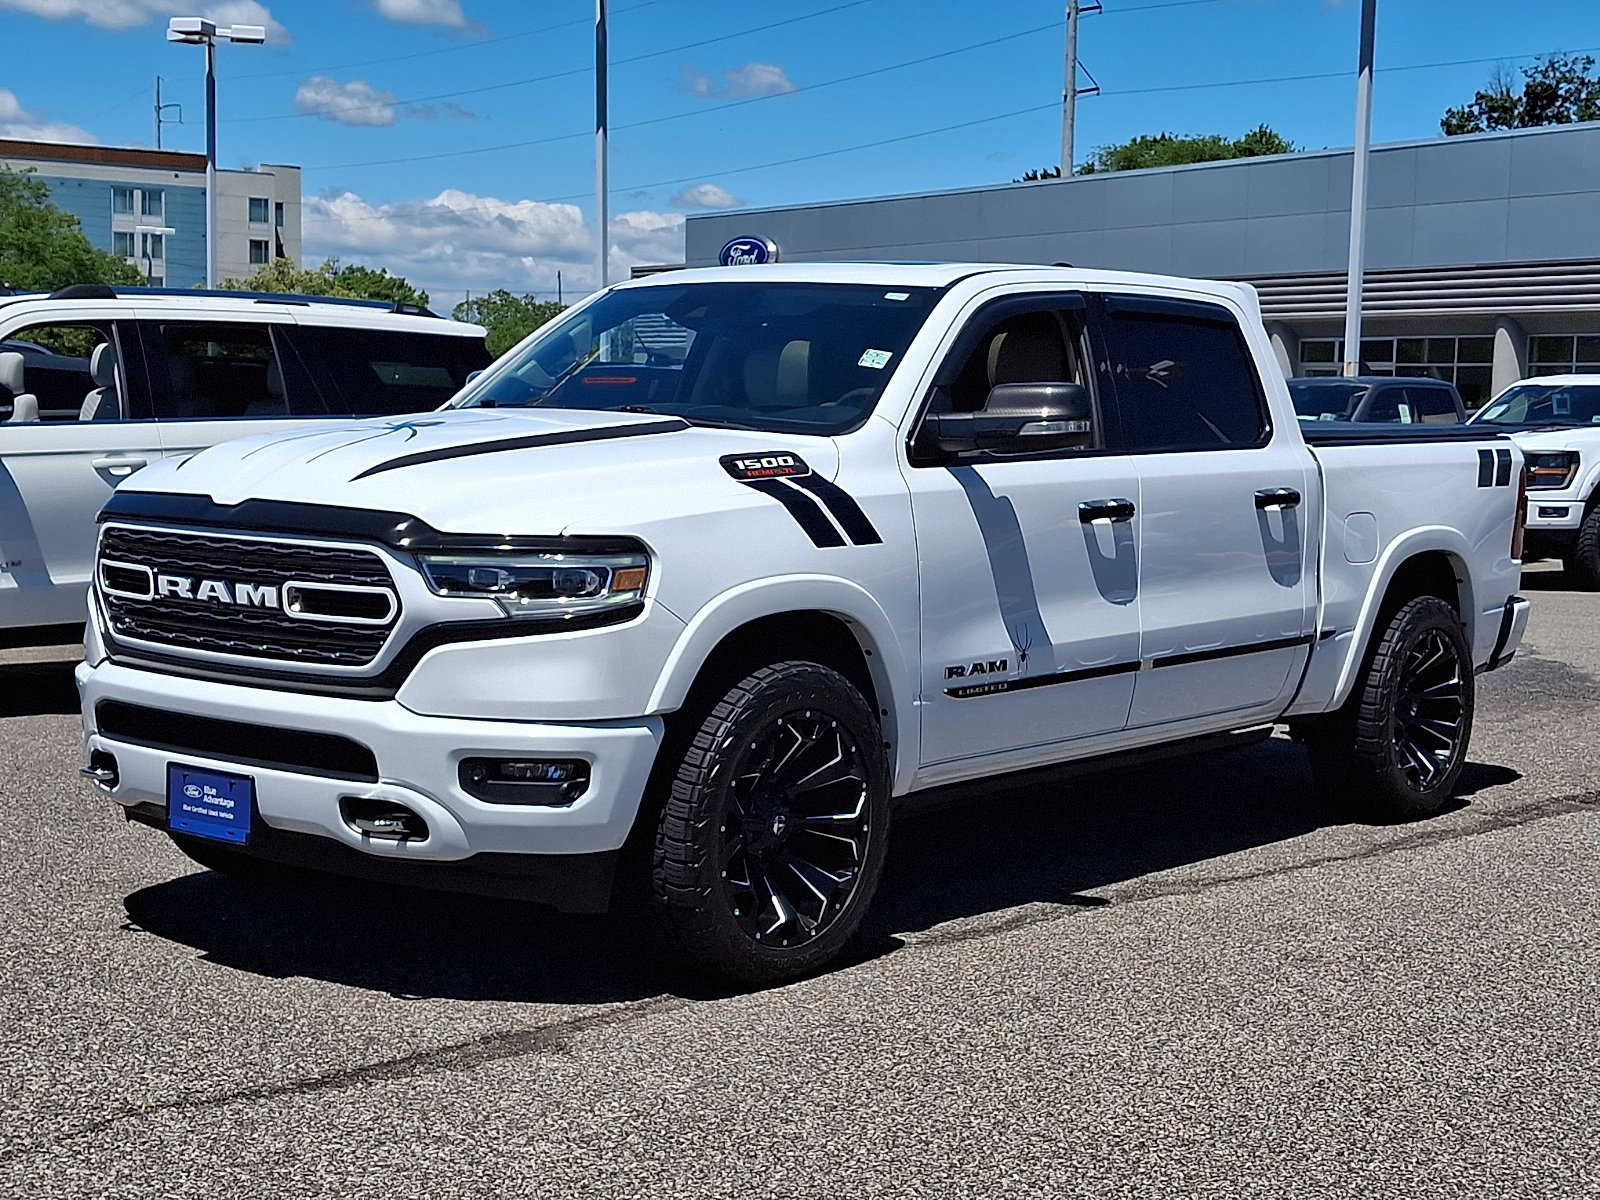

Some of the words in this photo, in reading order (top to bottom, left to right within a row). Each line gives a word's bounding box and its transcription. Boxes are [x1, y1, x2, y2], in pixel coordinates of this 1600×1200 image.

[734, 456, 794, 470] 1500
[158, 574, 279, 608] RAM
[944, 659, 1008, 679] RAM
[958, 683, 1008, 695] LIMITED
[204, 785, 216, 795] Blue
[203, 795, 234, 808] Advantage
